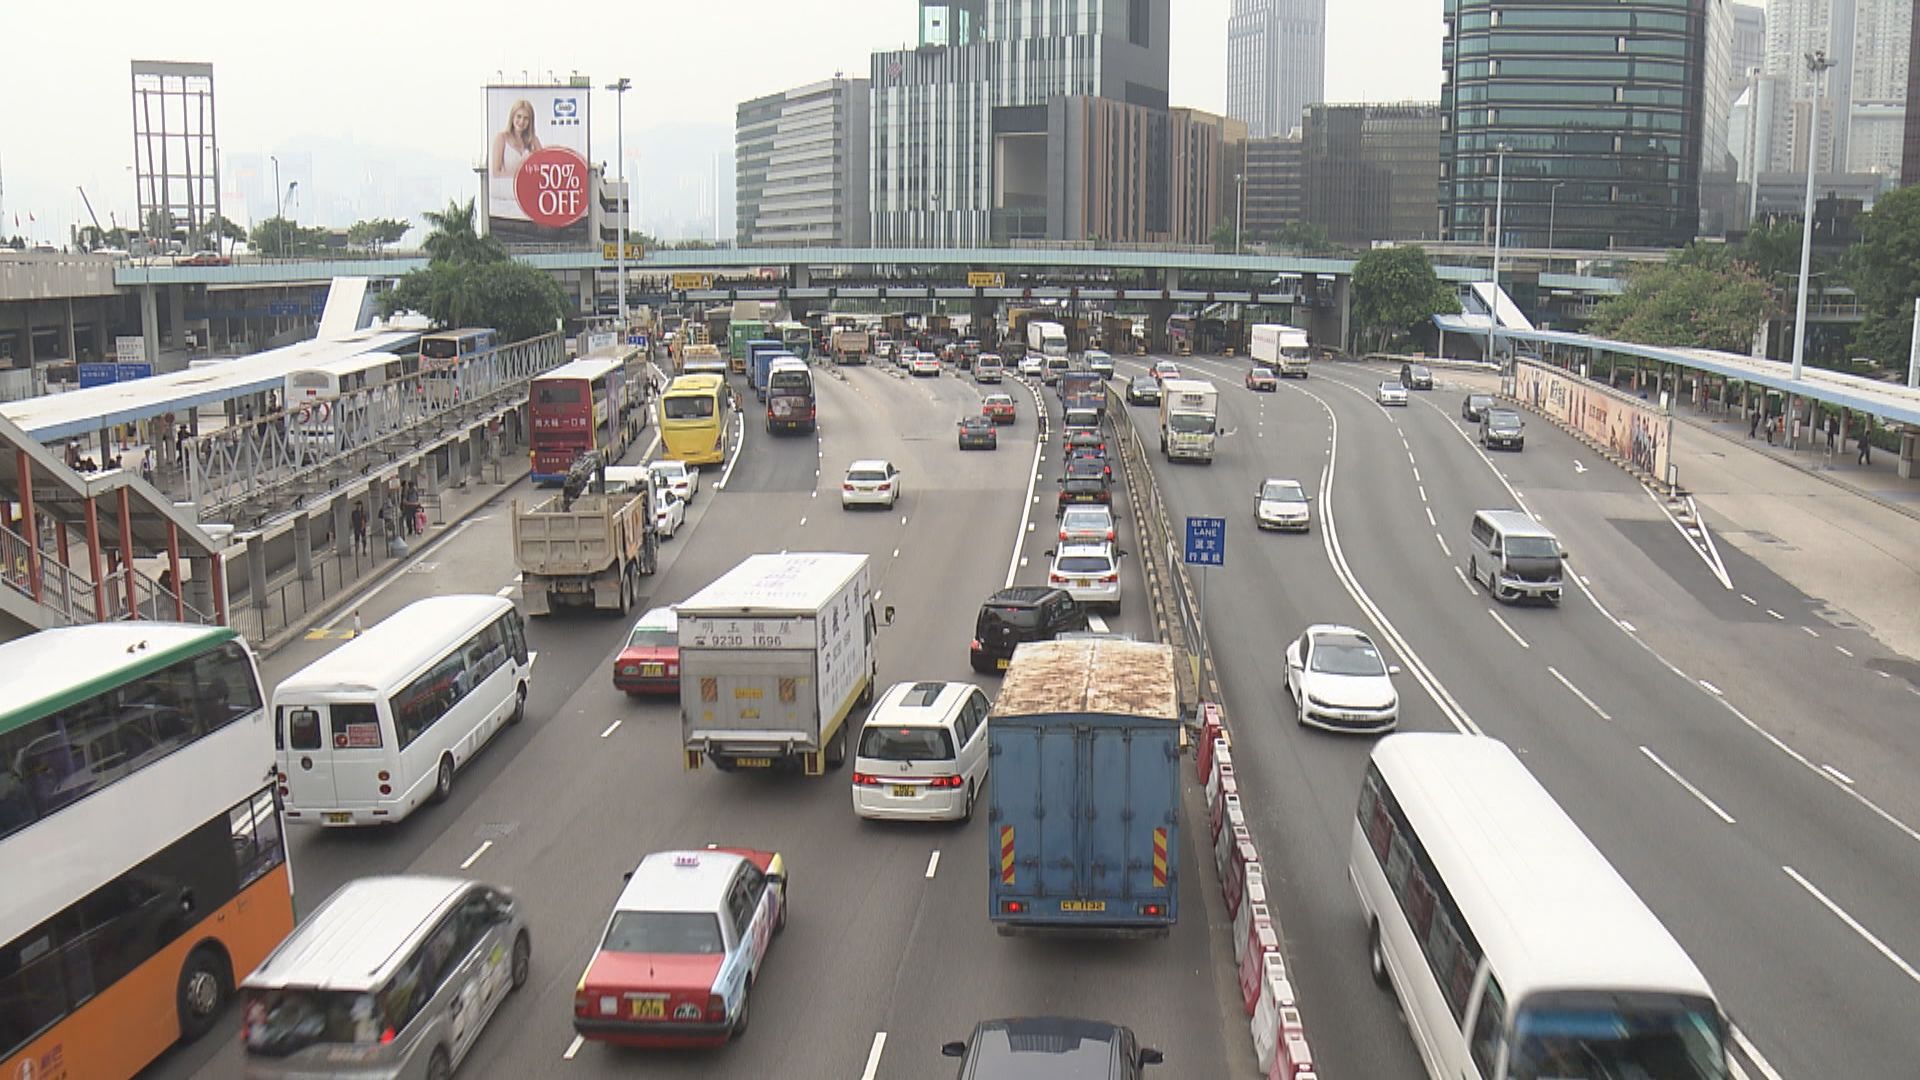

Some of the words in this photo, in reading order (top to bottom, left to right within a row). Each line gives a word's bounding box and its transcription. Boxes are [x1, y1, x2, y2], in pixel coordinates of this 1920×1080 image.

[539, 164, 580, 189] 50%
[538, 190, 580, 215] OFF
[1191, 520, 1208, 528] GET
[1211, 520, 1220, 528] IN
[1194, 528, 1217, 537] LANE
[712, 636, 743, 646] 9230
[752, 636, 782, 646] 1696
